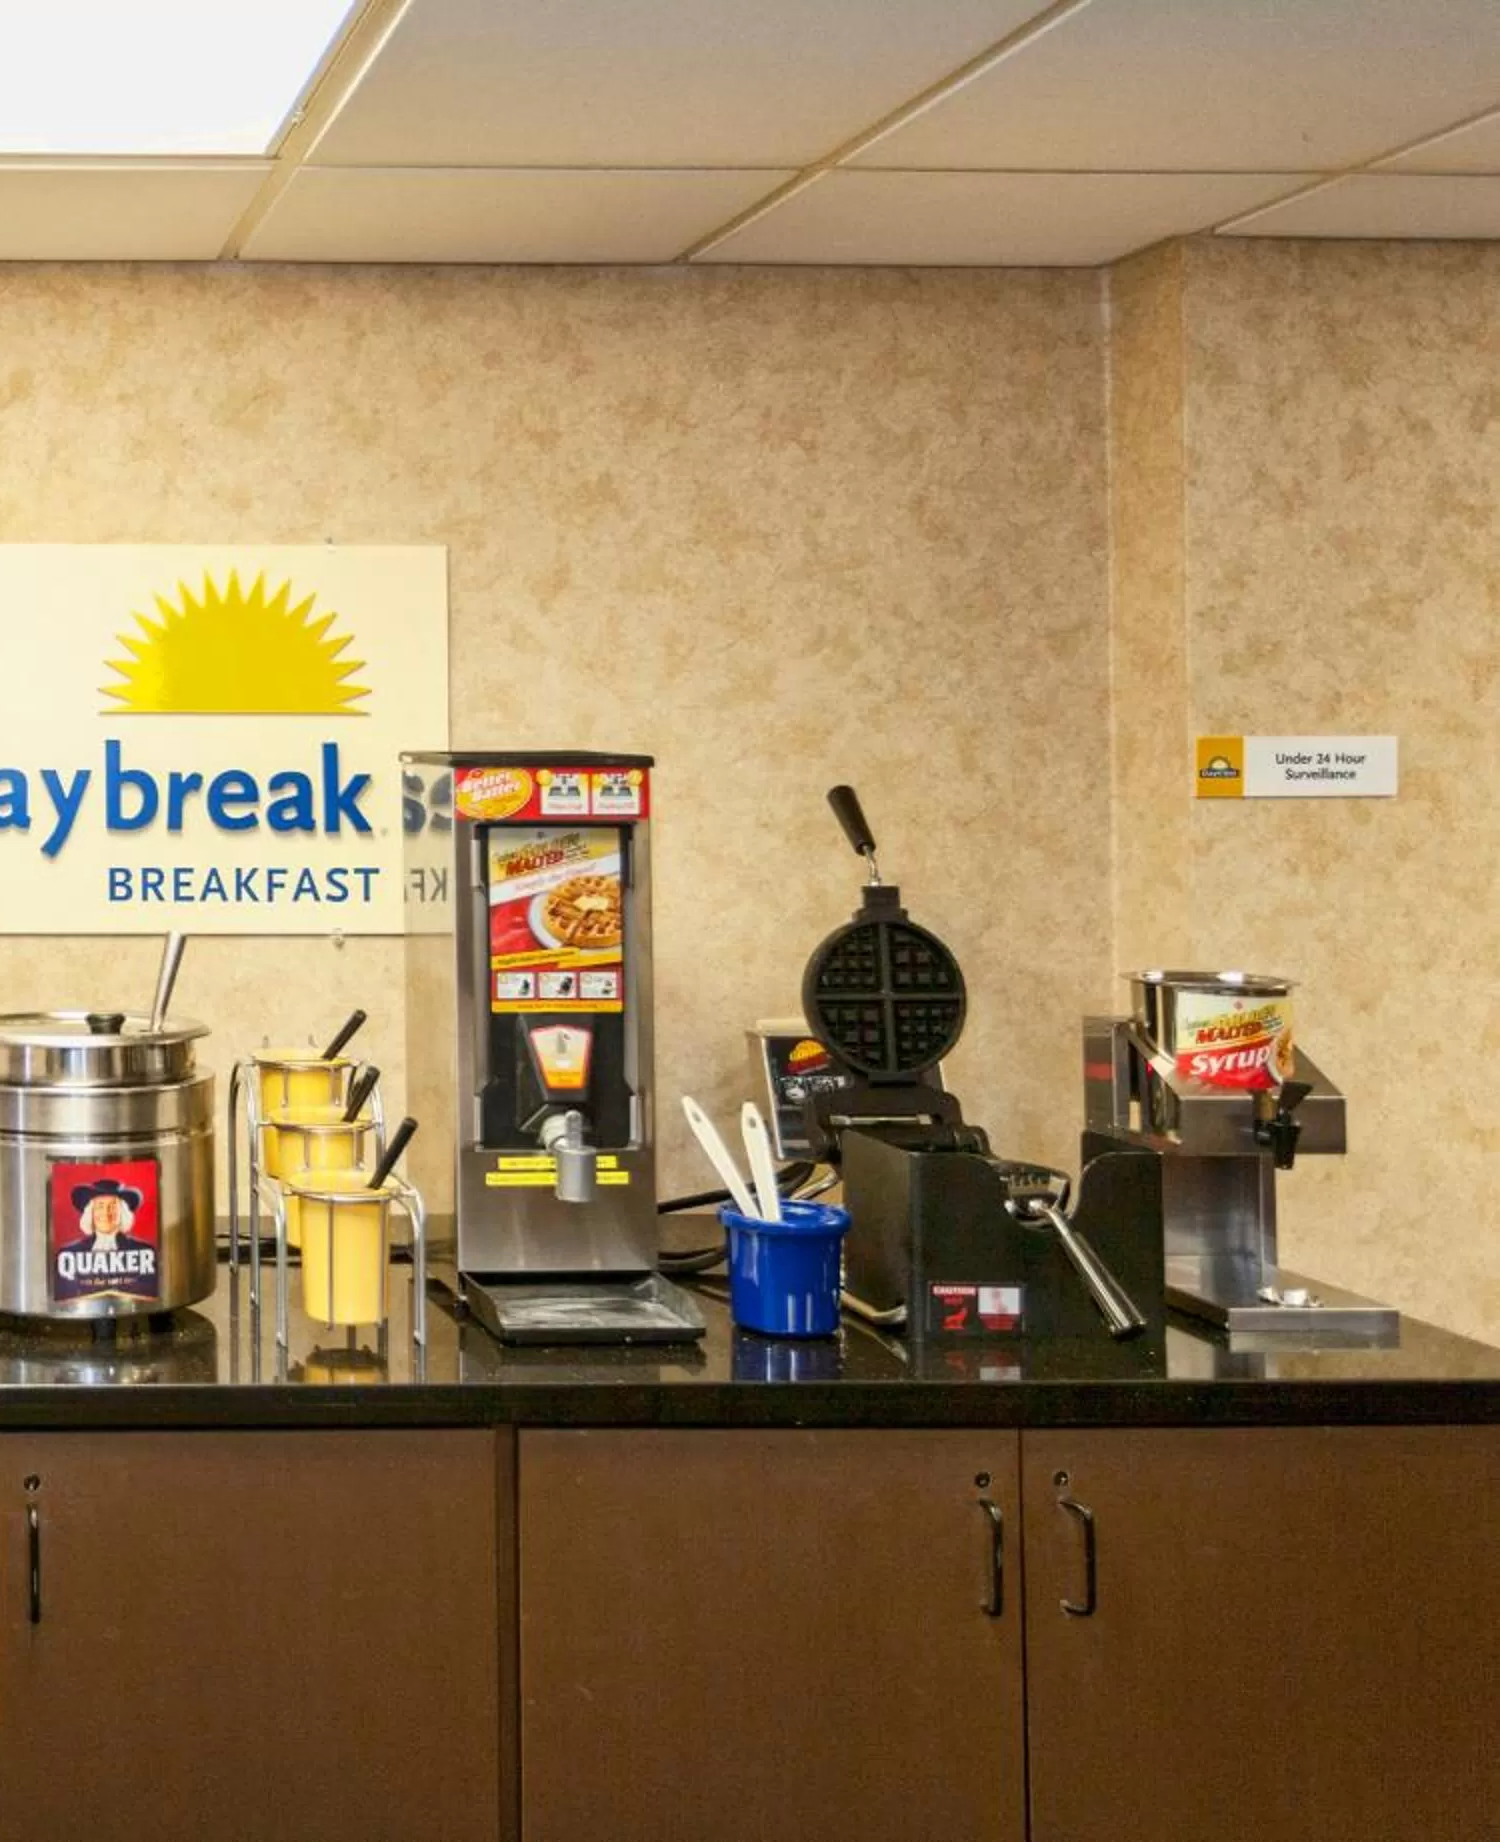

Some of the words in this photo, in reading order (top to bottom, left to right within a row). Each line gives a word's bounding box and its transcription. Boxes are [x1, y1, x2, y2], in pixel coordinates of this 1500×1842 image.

[1275, 753, 1313, 765] Under
[1317, 753, 1331, 765] 24
[1335, 753, 1367, 765] Hour
[1285, 768, 1357, 781] Surveillance
[109, 867, 381, 904] BREAKFAST
[1190, 1045, 1272, 1077] Syrup
[57, 1248, 156, 1281] QUAKER
